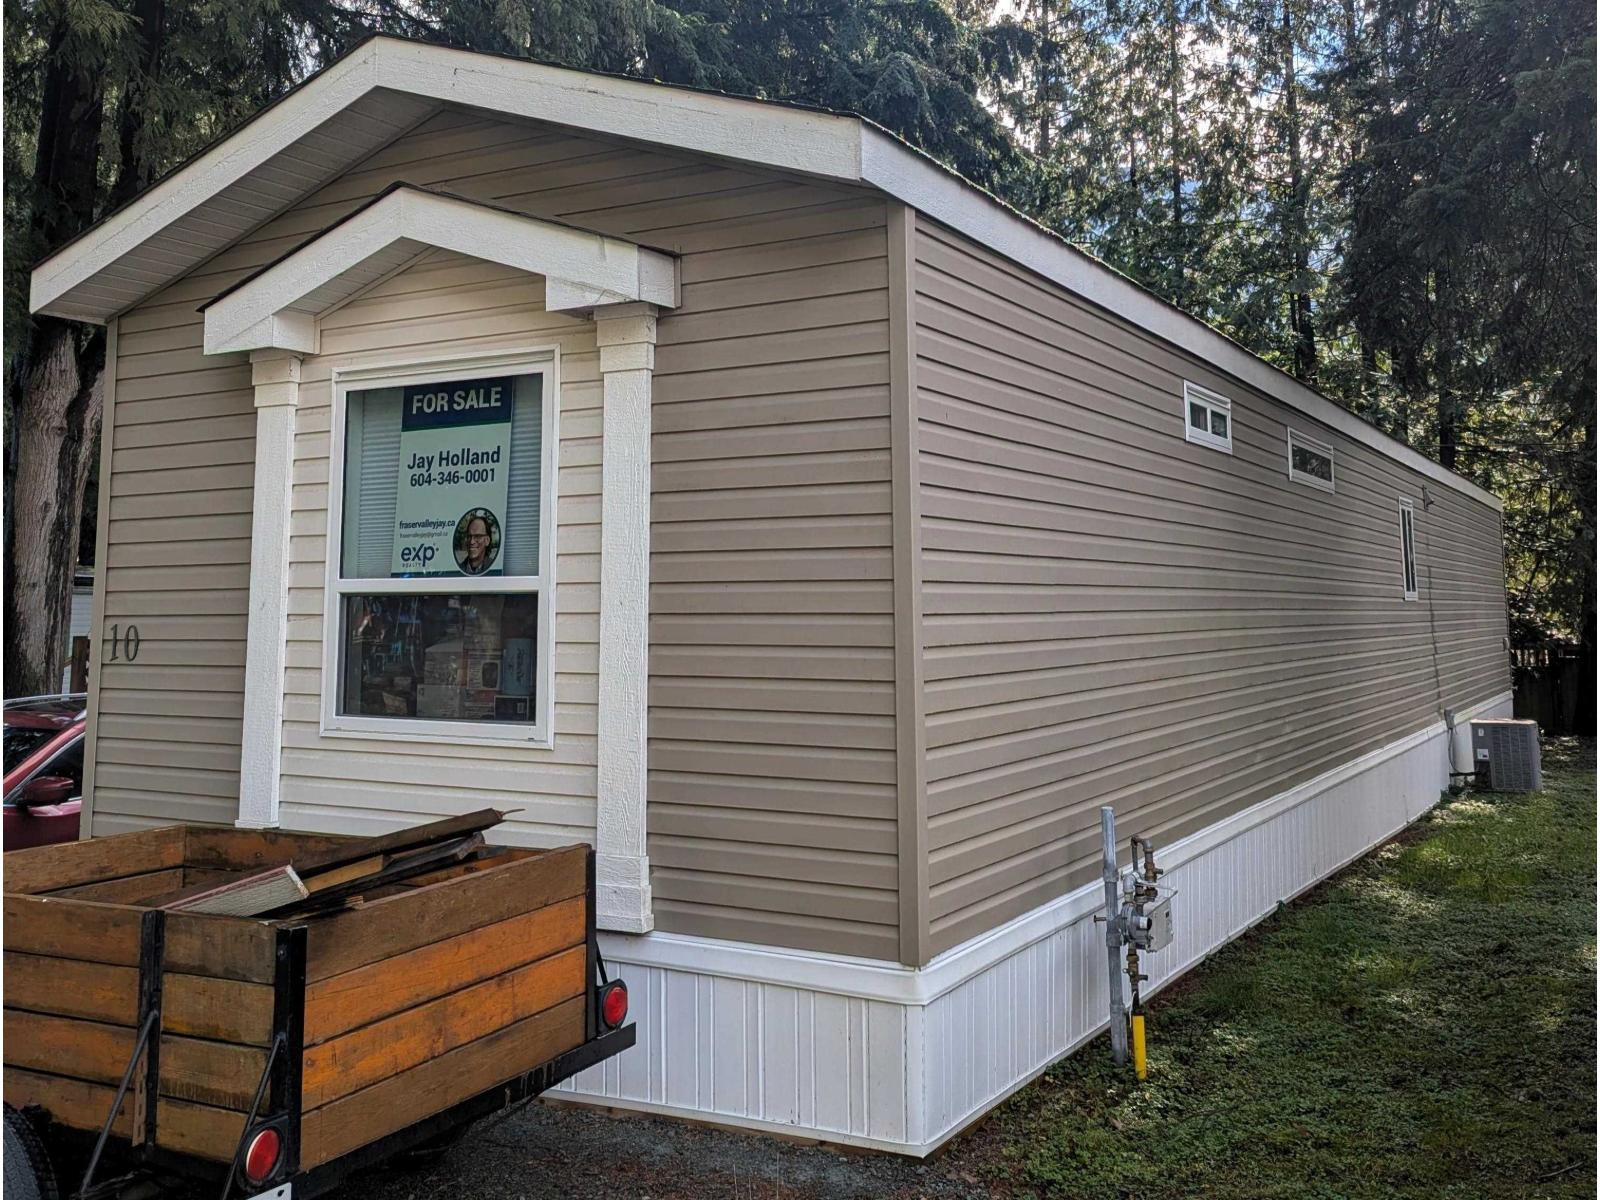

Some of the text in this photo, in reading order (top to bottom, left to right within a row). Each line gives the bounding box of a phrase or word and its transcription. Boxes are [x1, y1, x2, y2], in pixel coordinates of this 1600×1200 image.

[412, 387, 502, 415] FOR SALE
[407, 445, 501, 473] Jay Holland
[410, 468, 495, 487] 604-346-0001
[399, 518, 456, 530] fraservalleyjay.ca
[109, 624, 140, 662] 10
